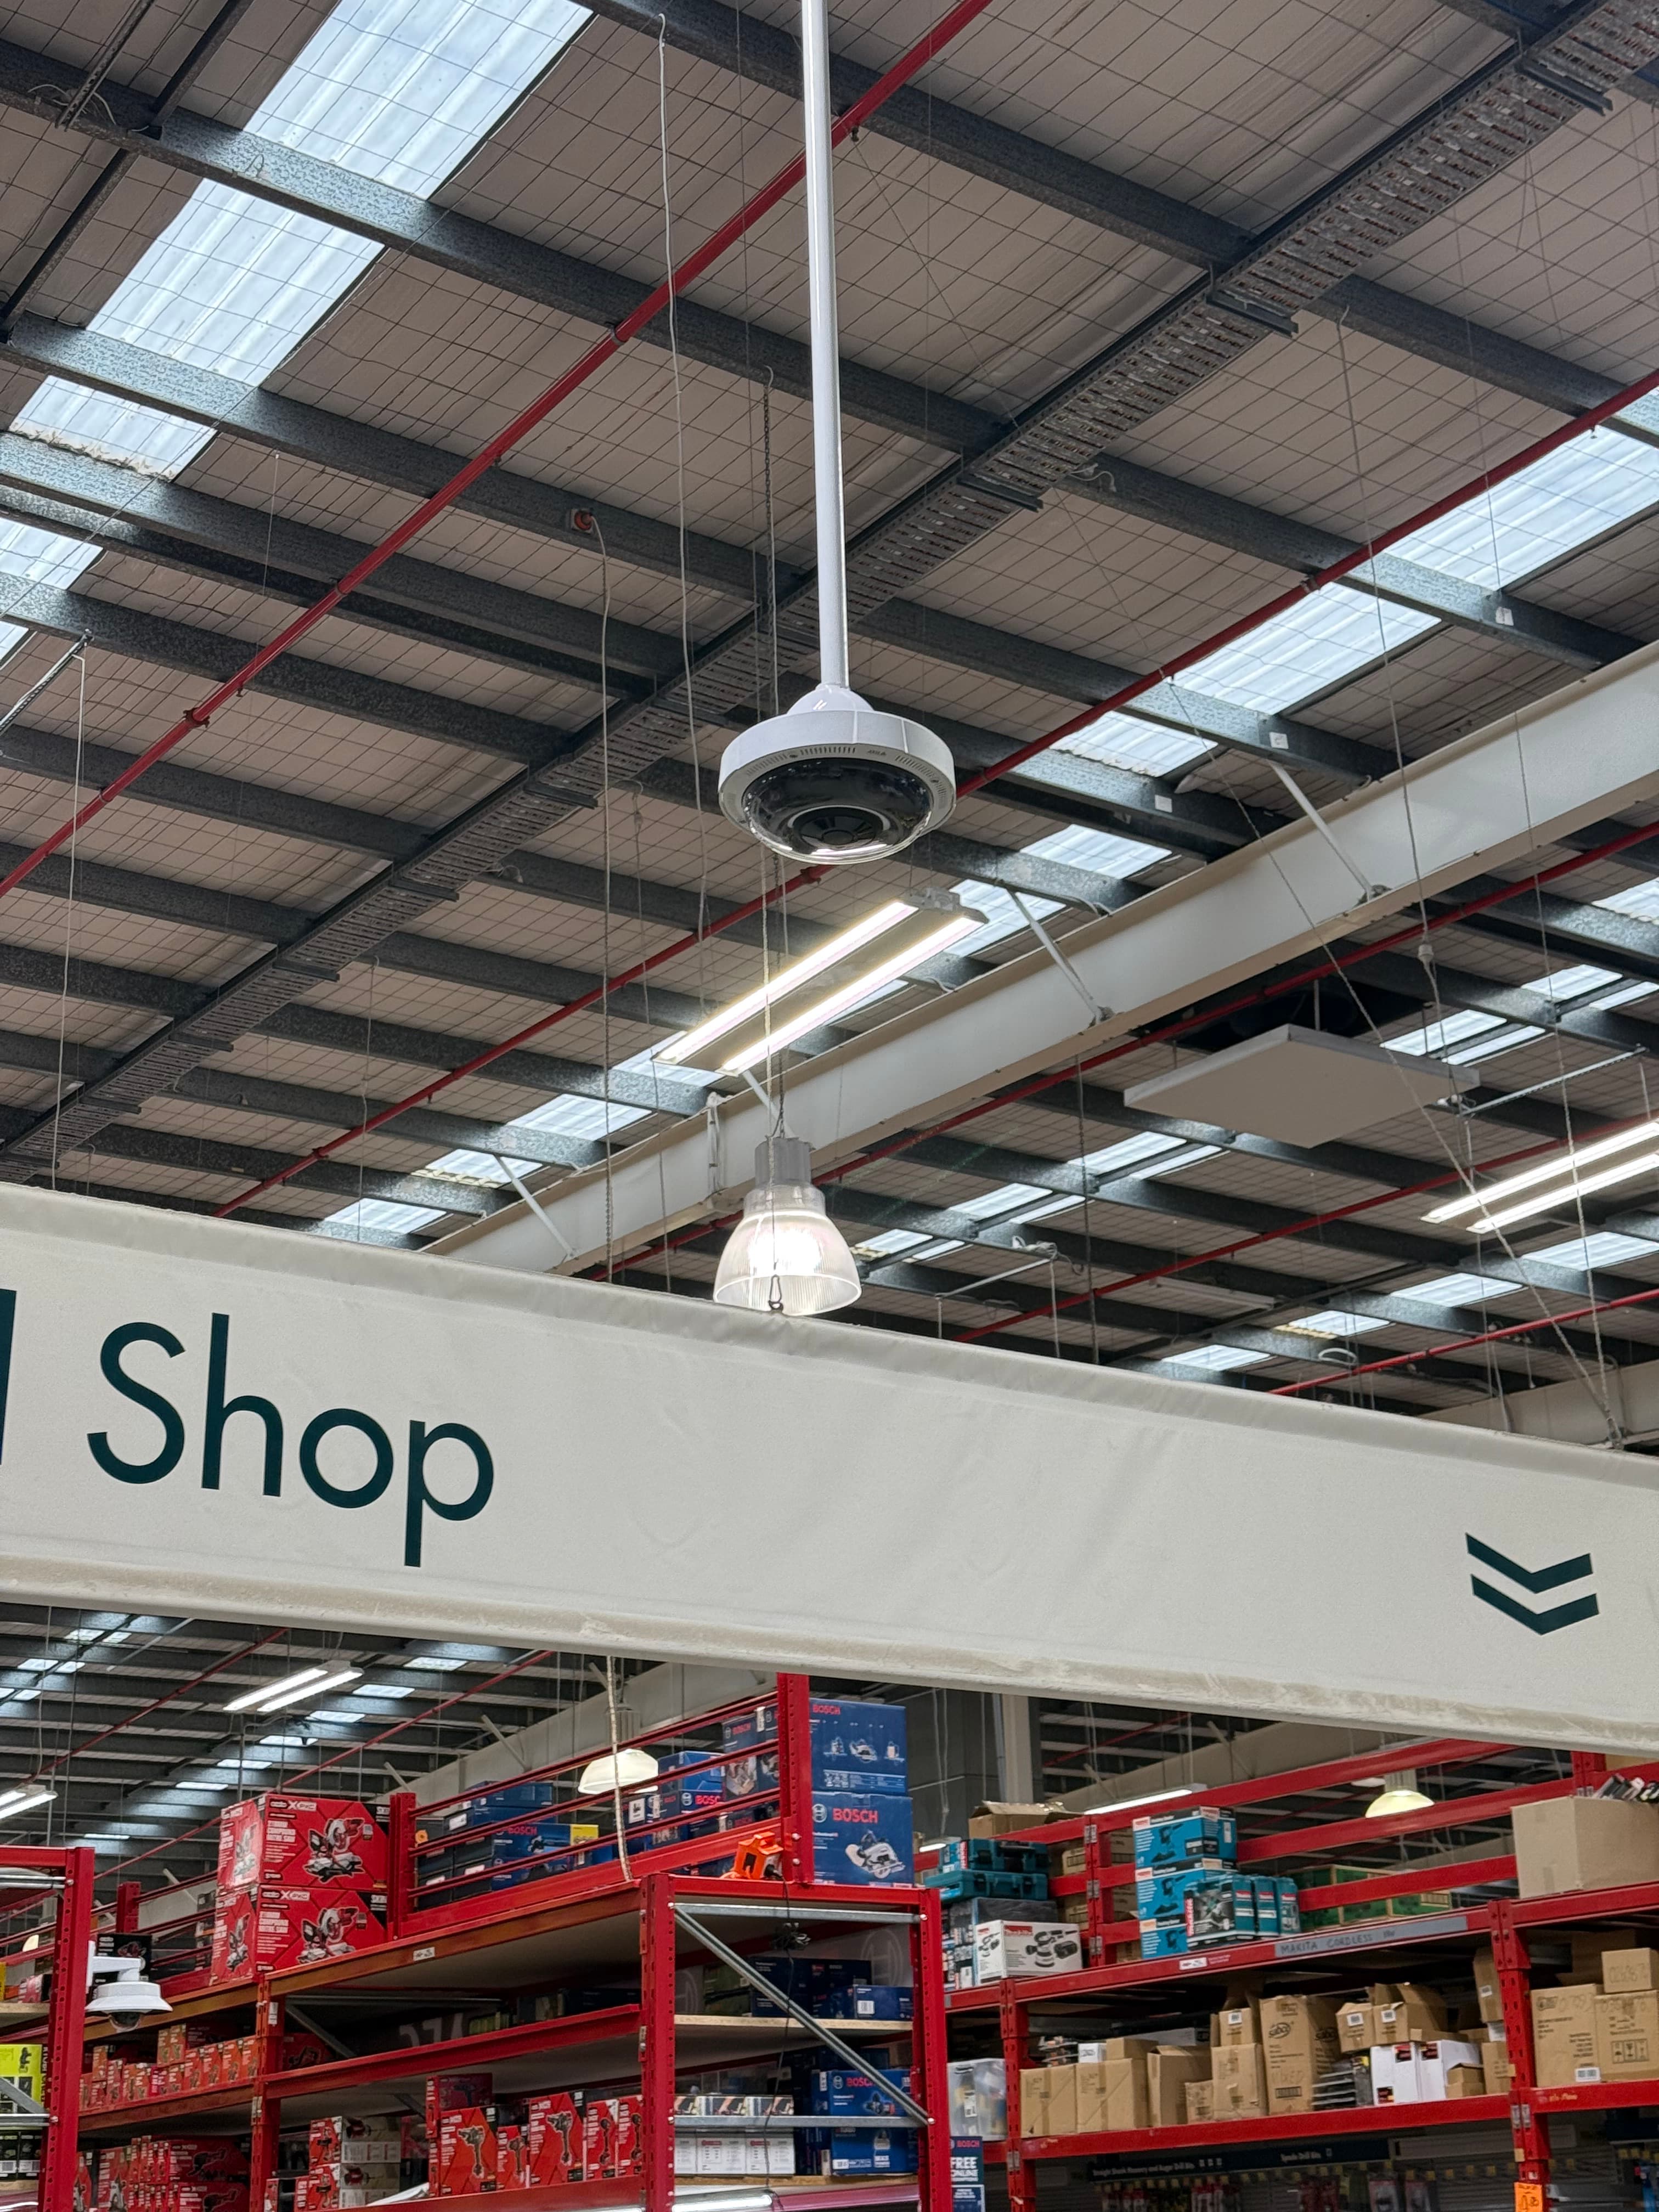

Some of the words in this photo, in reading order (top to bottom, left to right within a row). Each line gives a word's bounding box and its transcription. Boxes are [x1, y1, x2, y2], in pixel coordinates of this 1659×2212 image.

[87, 1312, 494, 1567] Shop
[812, 1704, 840, 1715] BOSCH
[695, 1795, 721, 1805] BOSC
[833, 1808, 878, 1824] BOSCH
[508, 1826, 537, 1835] BOSCH
[1280, 1941, 1318, 1955] MAKITA
[1326, 1933, 1373, 1948] CORDLESS
[847, 2077, 876, 2087] BOSC
[950, 2157, 978, 2169] FREE
